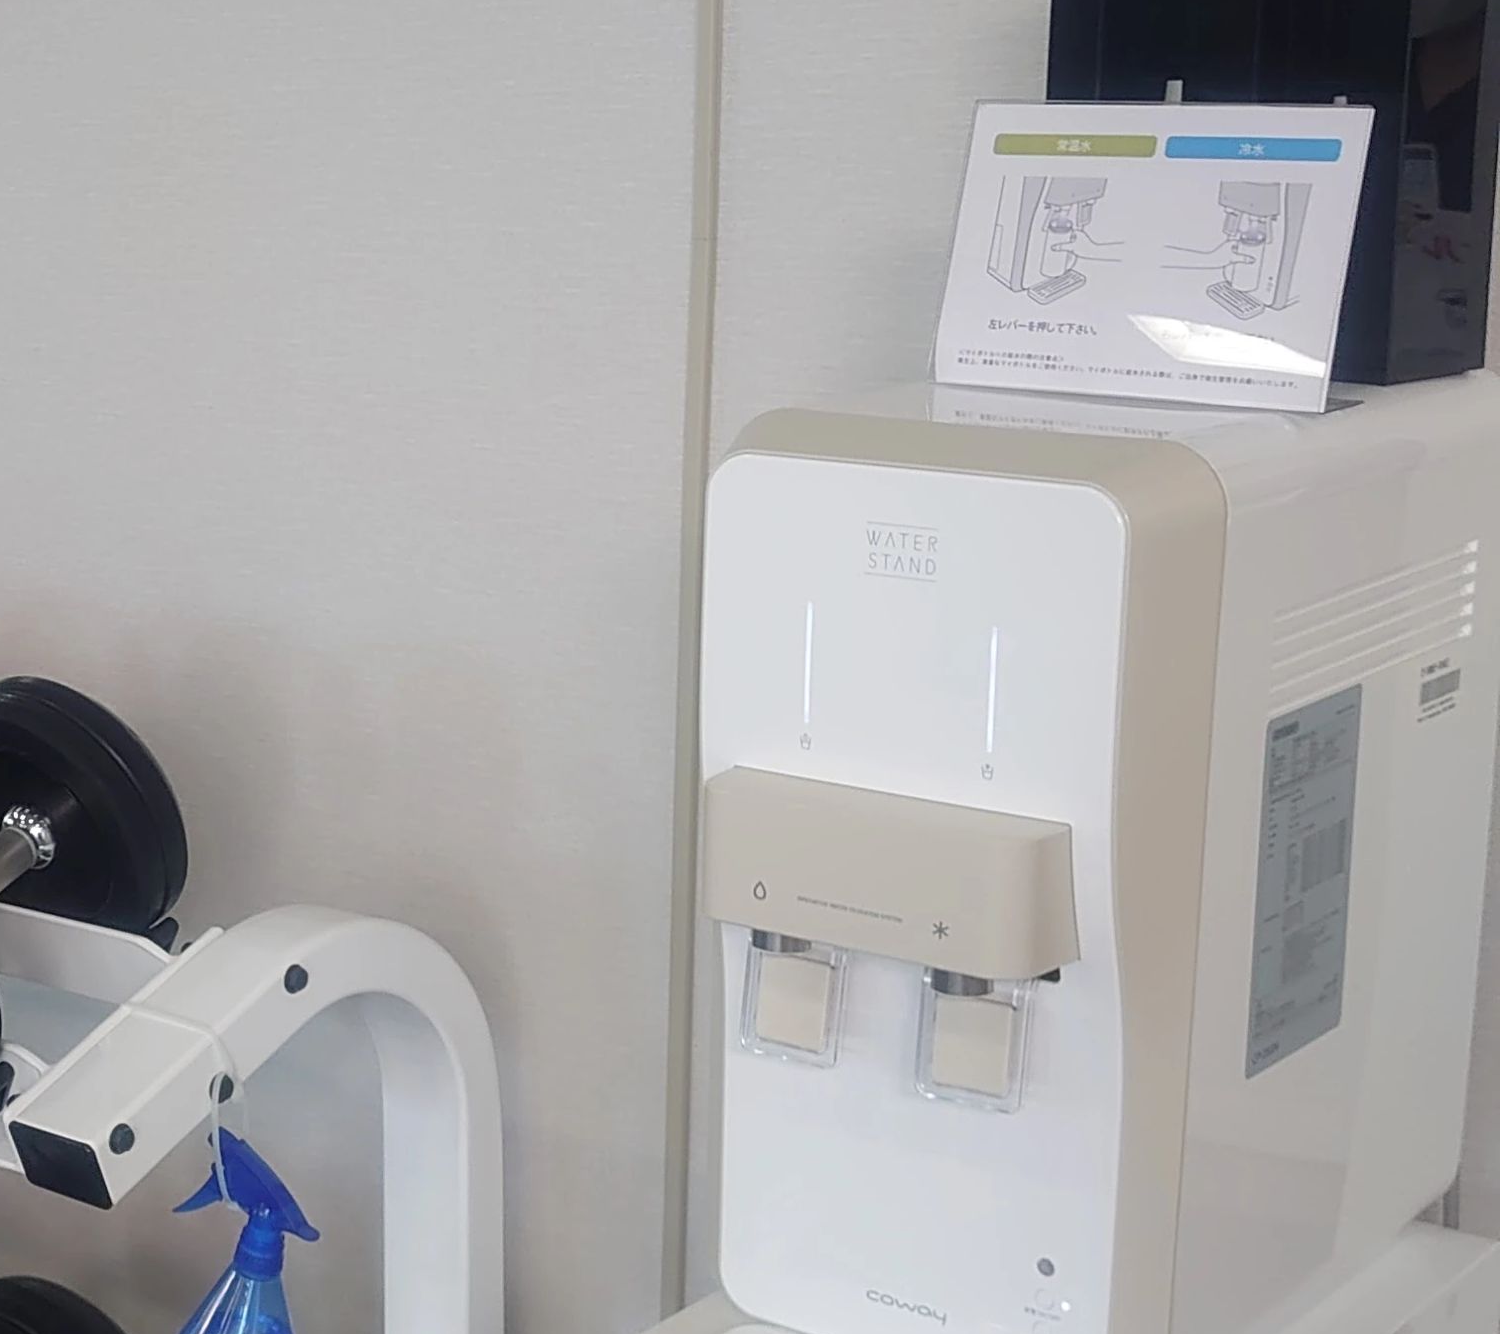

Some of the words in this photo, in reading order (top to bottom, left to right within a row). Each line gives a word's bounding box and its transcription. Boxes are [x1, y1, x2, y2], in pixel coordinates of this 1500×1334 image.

[1238, 143, 1266, 157] 冷水
[866, 529, 939, 553] WATER
[867, 552, 938, 577] STAND
